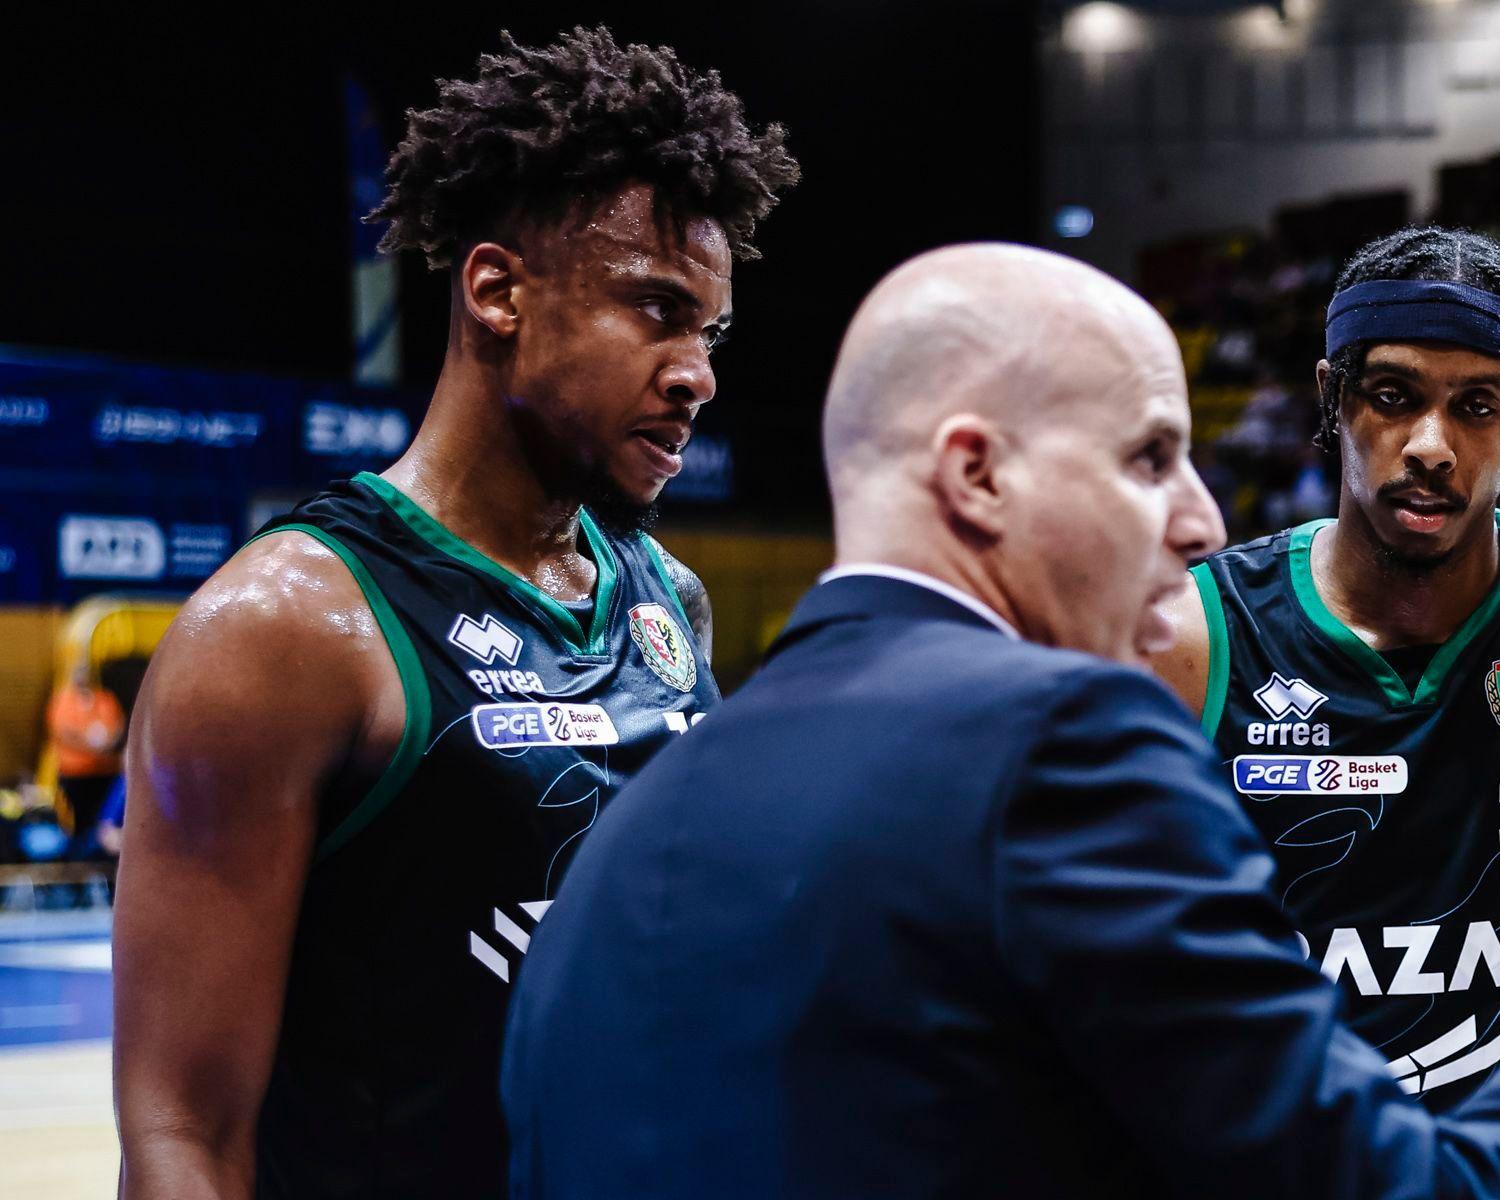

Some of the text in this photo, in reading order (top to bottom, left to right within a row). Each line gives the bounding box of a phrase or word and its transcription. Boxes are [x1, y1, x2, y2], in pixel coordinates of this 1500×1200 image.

[569, 709, 604, 724] Basket
[492, 713, 541, 737] PGE
[575, 726, 598, 742] Liga
[1246, 765, 1301, 784] PGE
[1348, 761, 1398, 775] Basket
[1348, 776, 1379, 790] Liga
